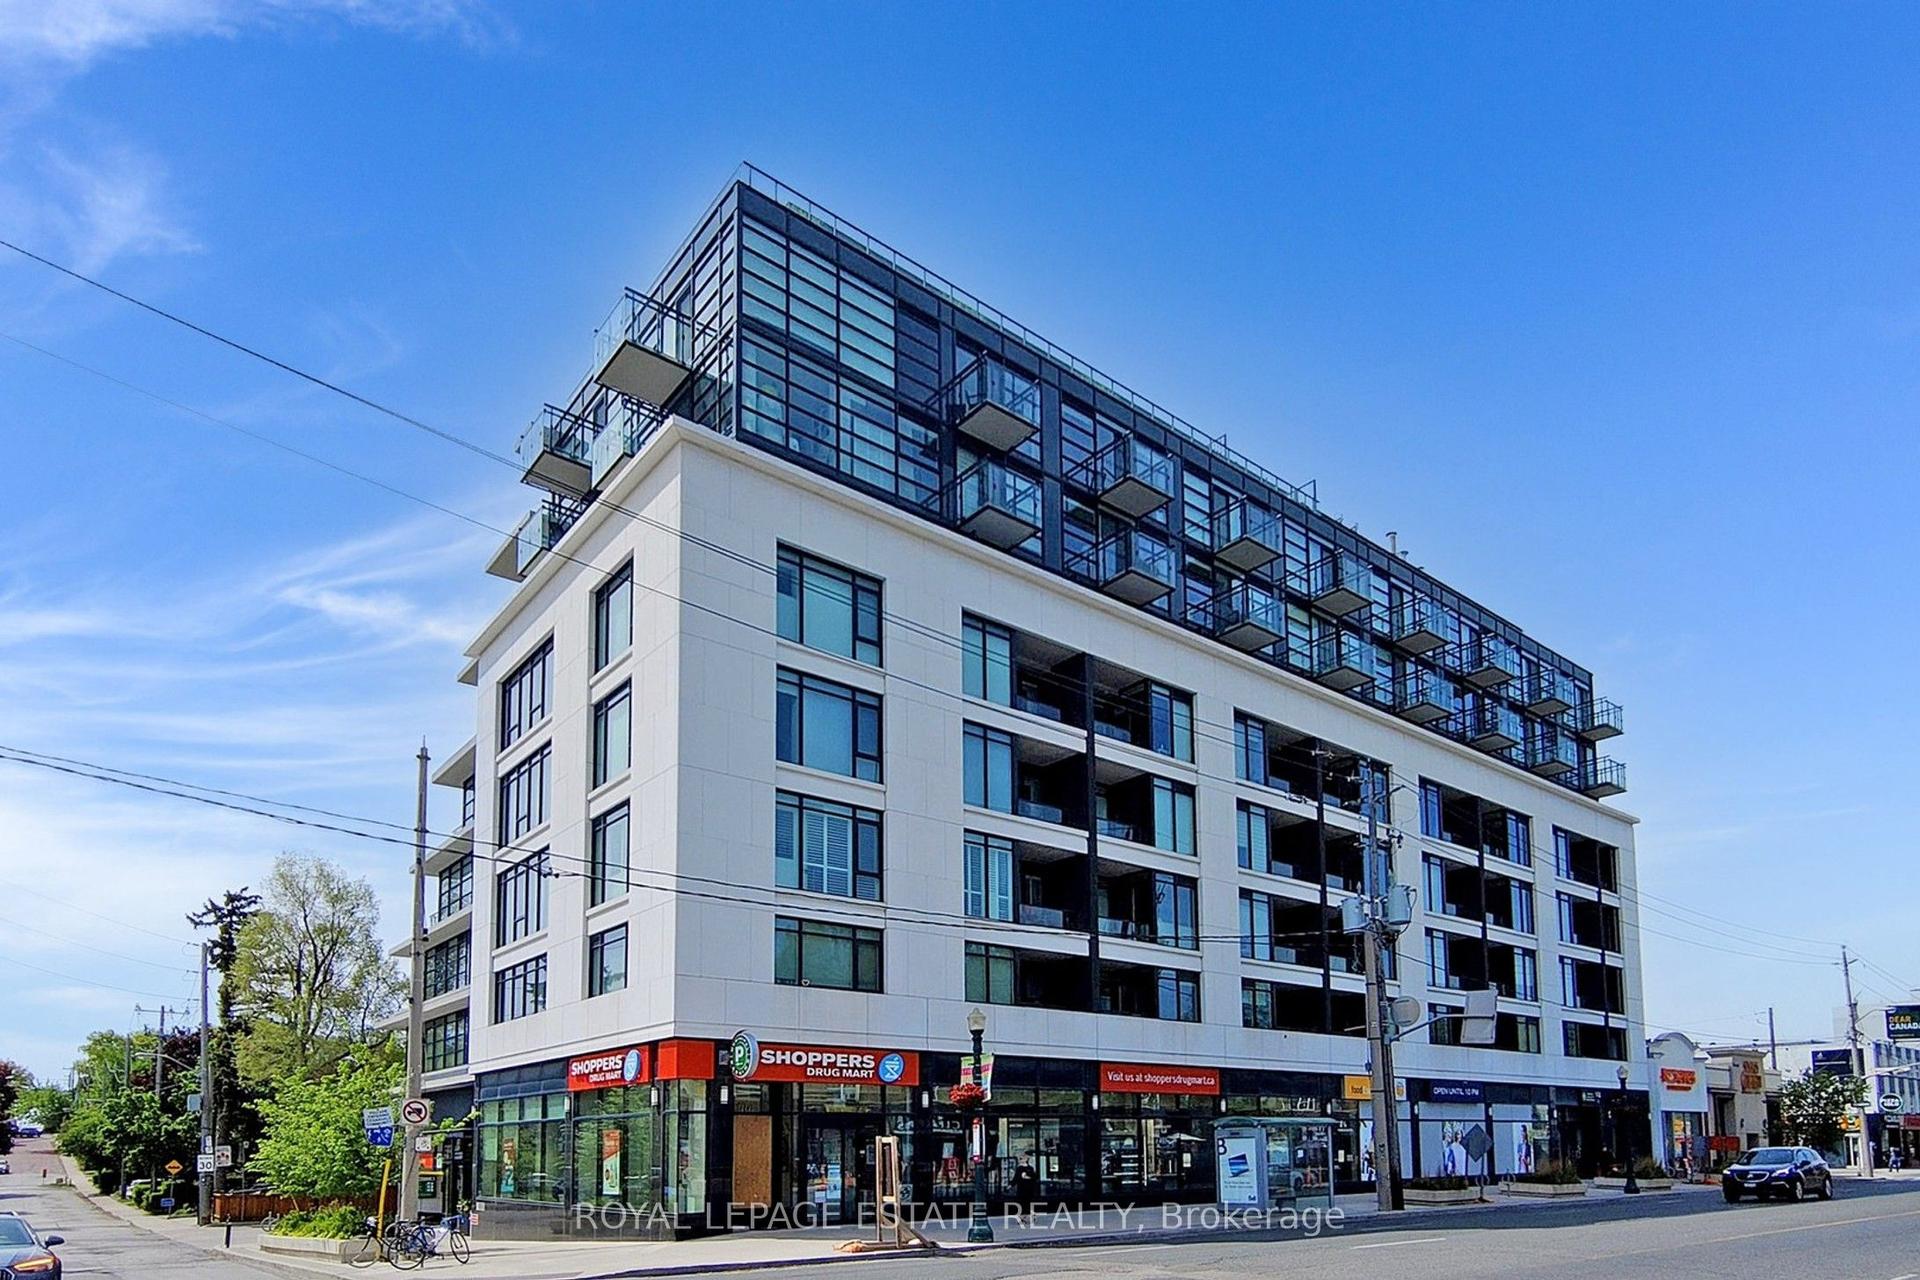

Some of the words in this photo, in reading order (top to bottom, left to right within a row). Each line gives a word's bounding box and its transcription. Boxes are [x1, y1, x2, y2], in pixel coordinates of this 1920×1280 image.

[1889, 1015, 1911, 1023] DEAR
[1889, 1022, 1920, 1031] CANAD
[761, 1050, 875, 1069] SHOPPERS
[571, 1054, 624, 1076] SHOPPERS
[589, 1072, 605, 1083] DRUG
[605, 1070, 622, 1081] MART
[806, 1068, 840, 1077] DRUG
[842, 1068, 875, 1078] MART
[1107, 1071, 1124, 1082] Visit
[1124, 1073, 1134, 1082] us
[1135, 1072, 1143, 1083] at
[1144, 1072, 1215, 1087] shoppersdrugmart.ca
[1351, 1085, 1363, 1094] food
[1433, 1086, 1448, 1095] OPEN
